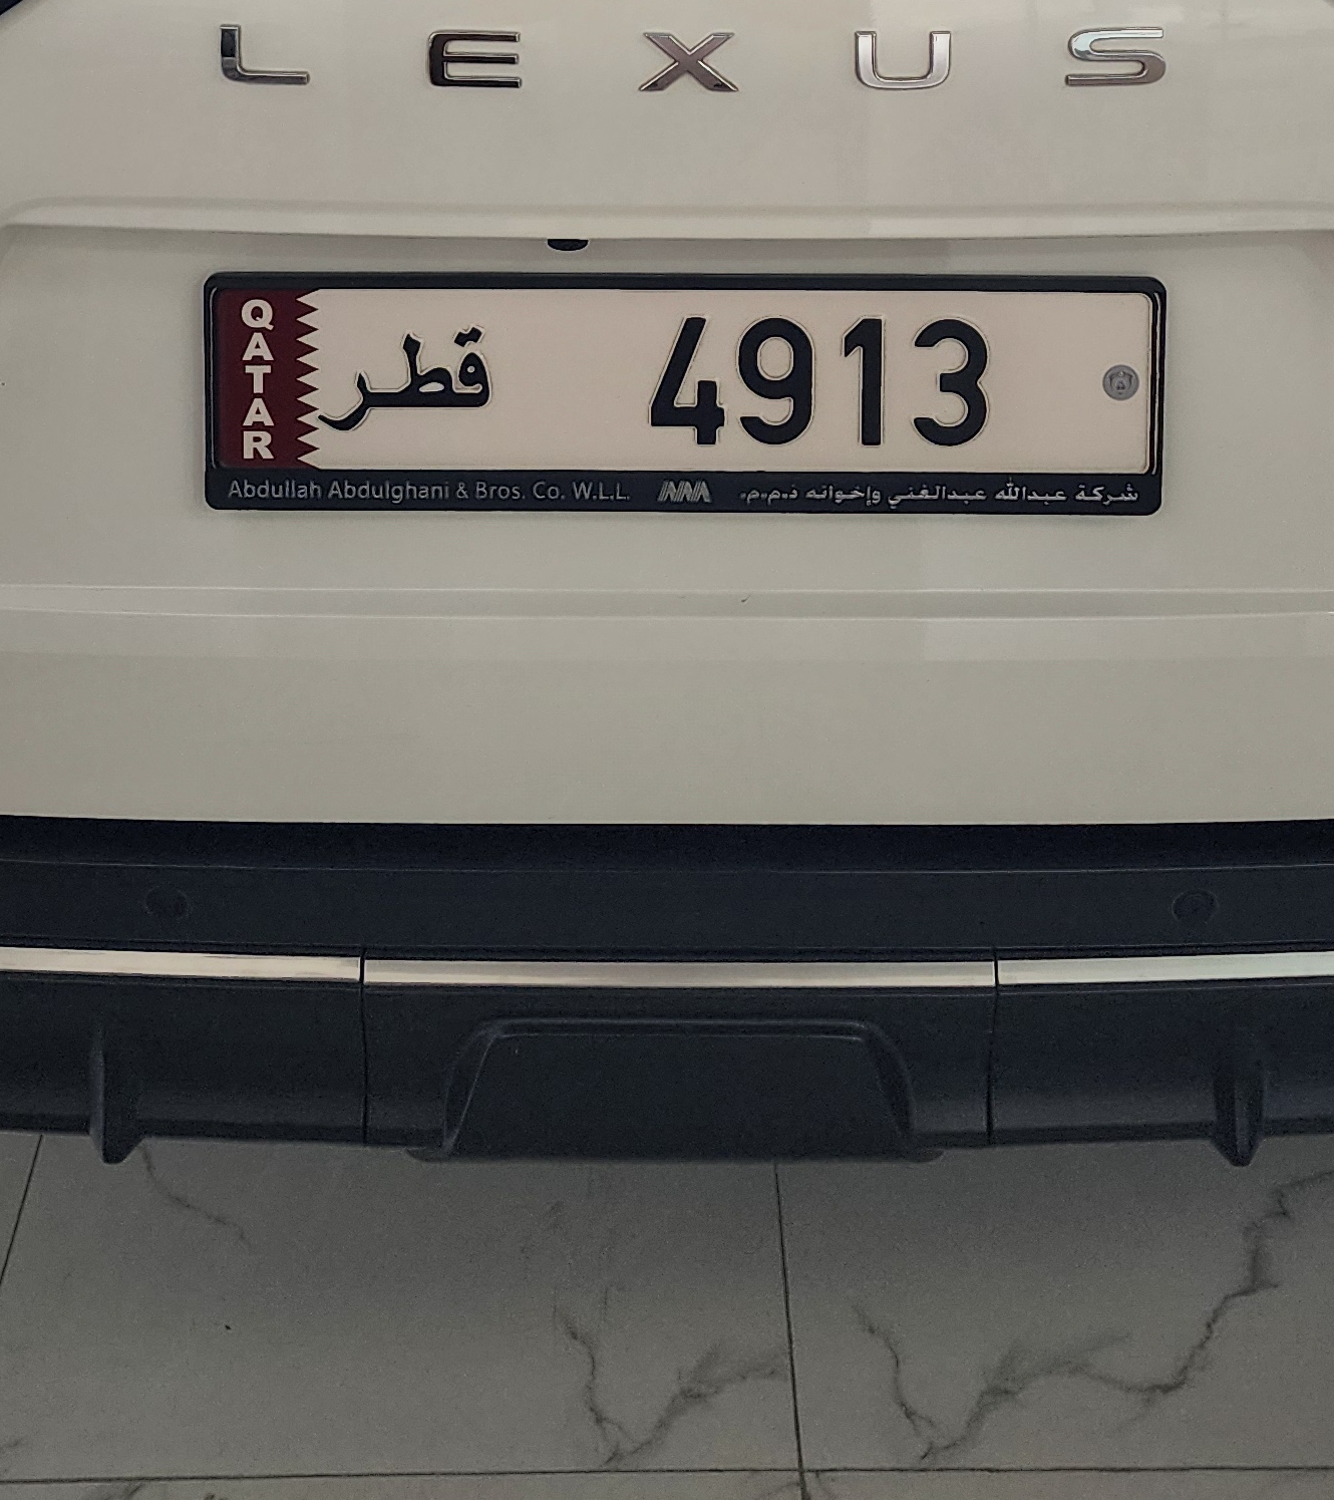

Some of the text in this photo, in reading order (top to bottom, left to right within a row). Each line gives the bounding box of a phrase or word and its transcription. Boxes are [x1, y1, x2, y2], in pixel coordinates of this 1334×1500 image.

[219, 23, 1169, 92] LEXUS
[241, 299, 274, 459] QATAR
[317, 326, 489, 431] قطر
[650, 317, 989, 446] 4913
[228, 479, 631, 504] Abdullah Abdulghani & Bros. Co. W.L.L.
[1075, 483, 1139, 506] شركة
